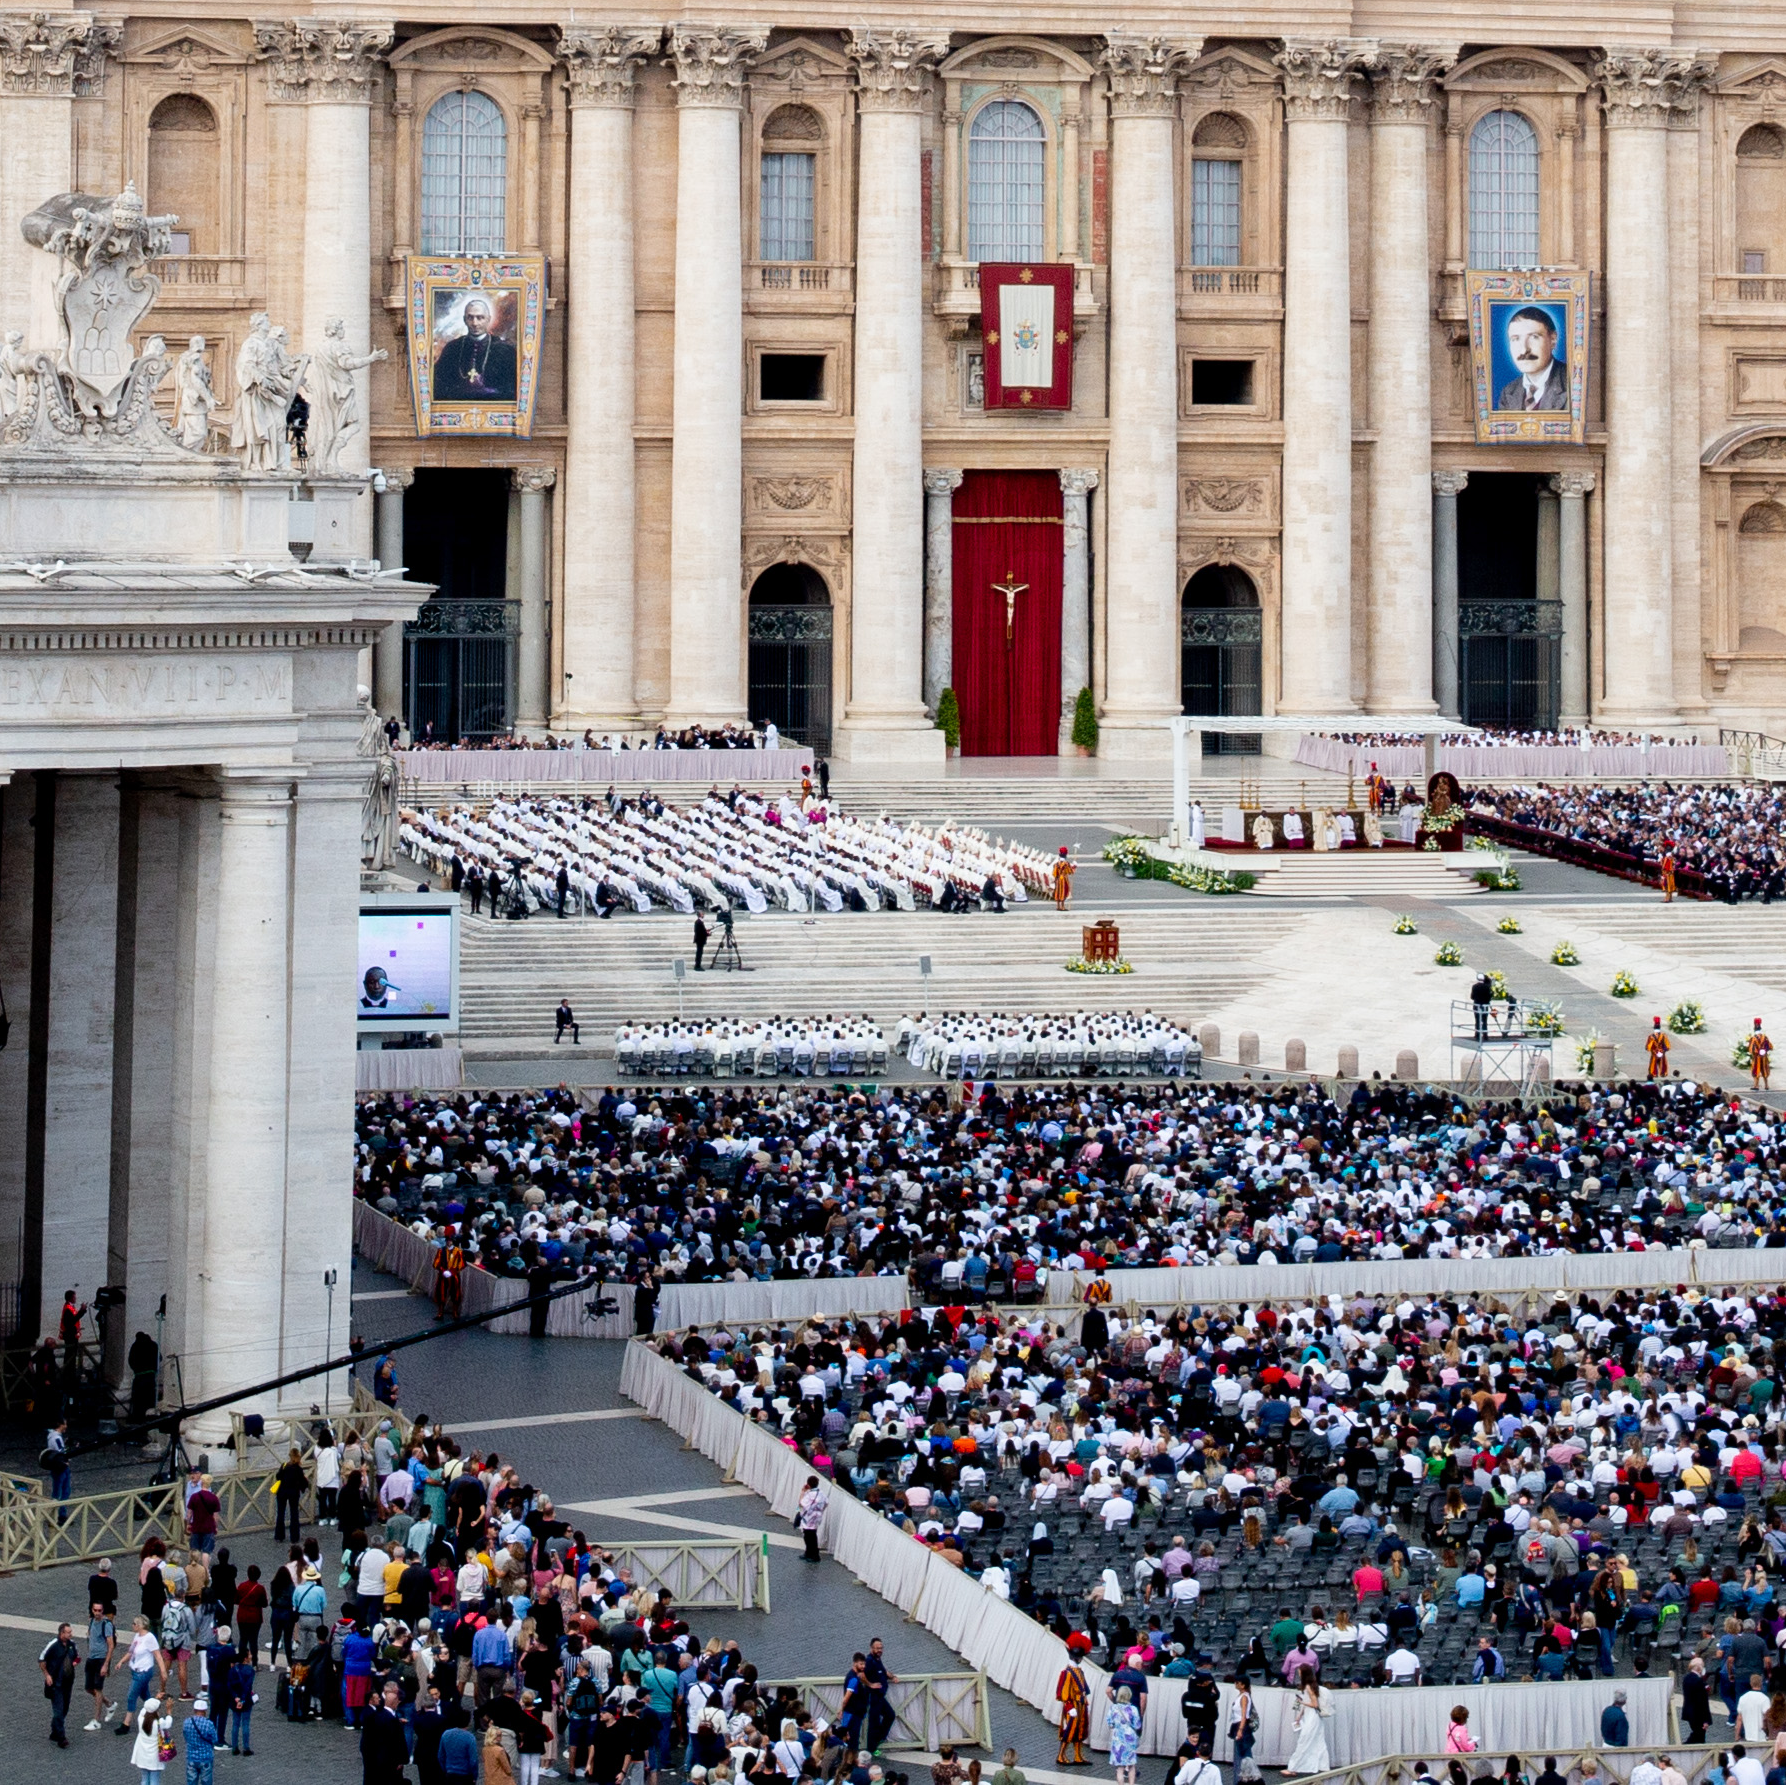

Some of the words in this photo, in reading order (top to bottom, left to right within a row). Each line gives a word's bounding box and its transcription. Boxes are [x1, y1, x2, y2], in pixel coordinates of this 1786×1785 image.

[130, 664, 199, 702] VII
[216, 664, 237, 701] P
[253, 662, 287, 701] M
